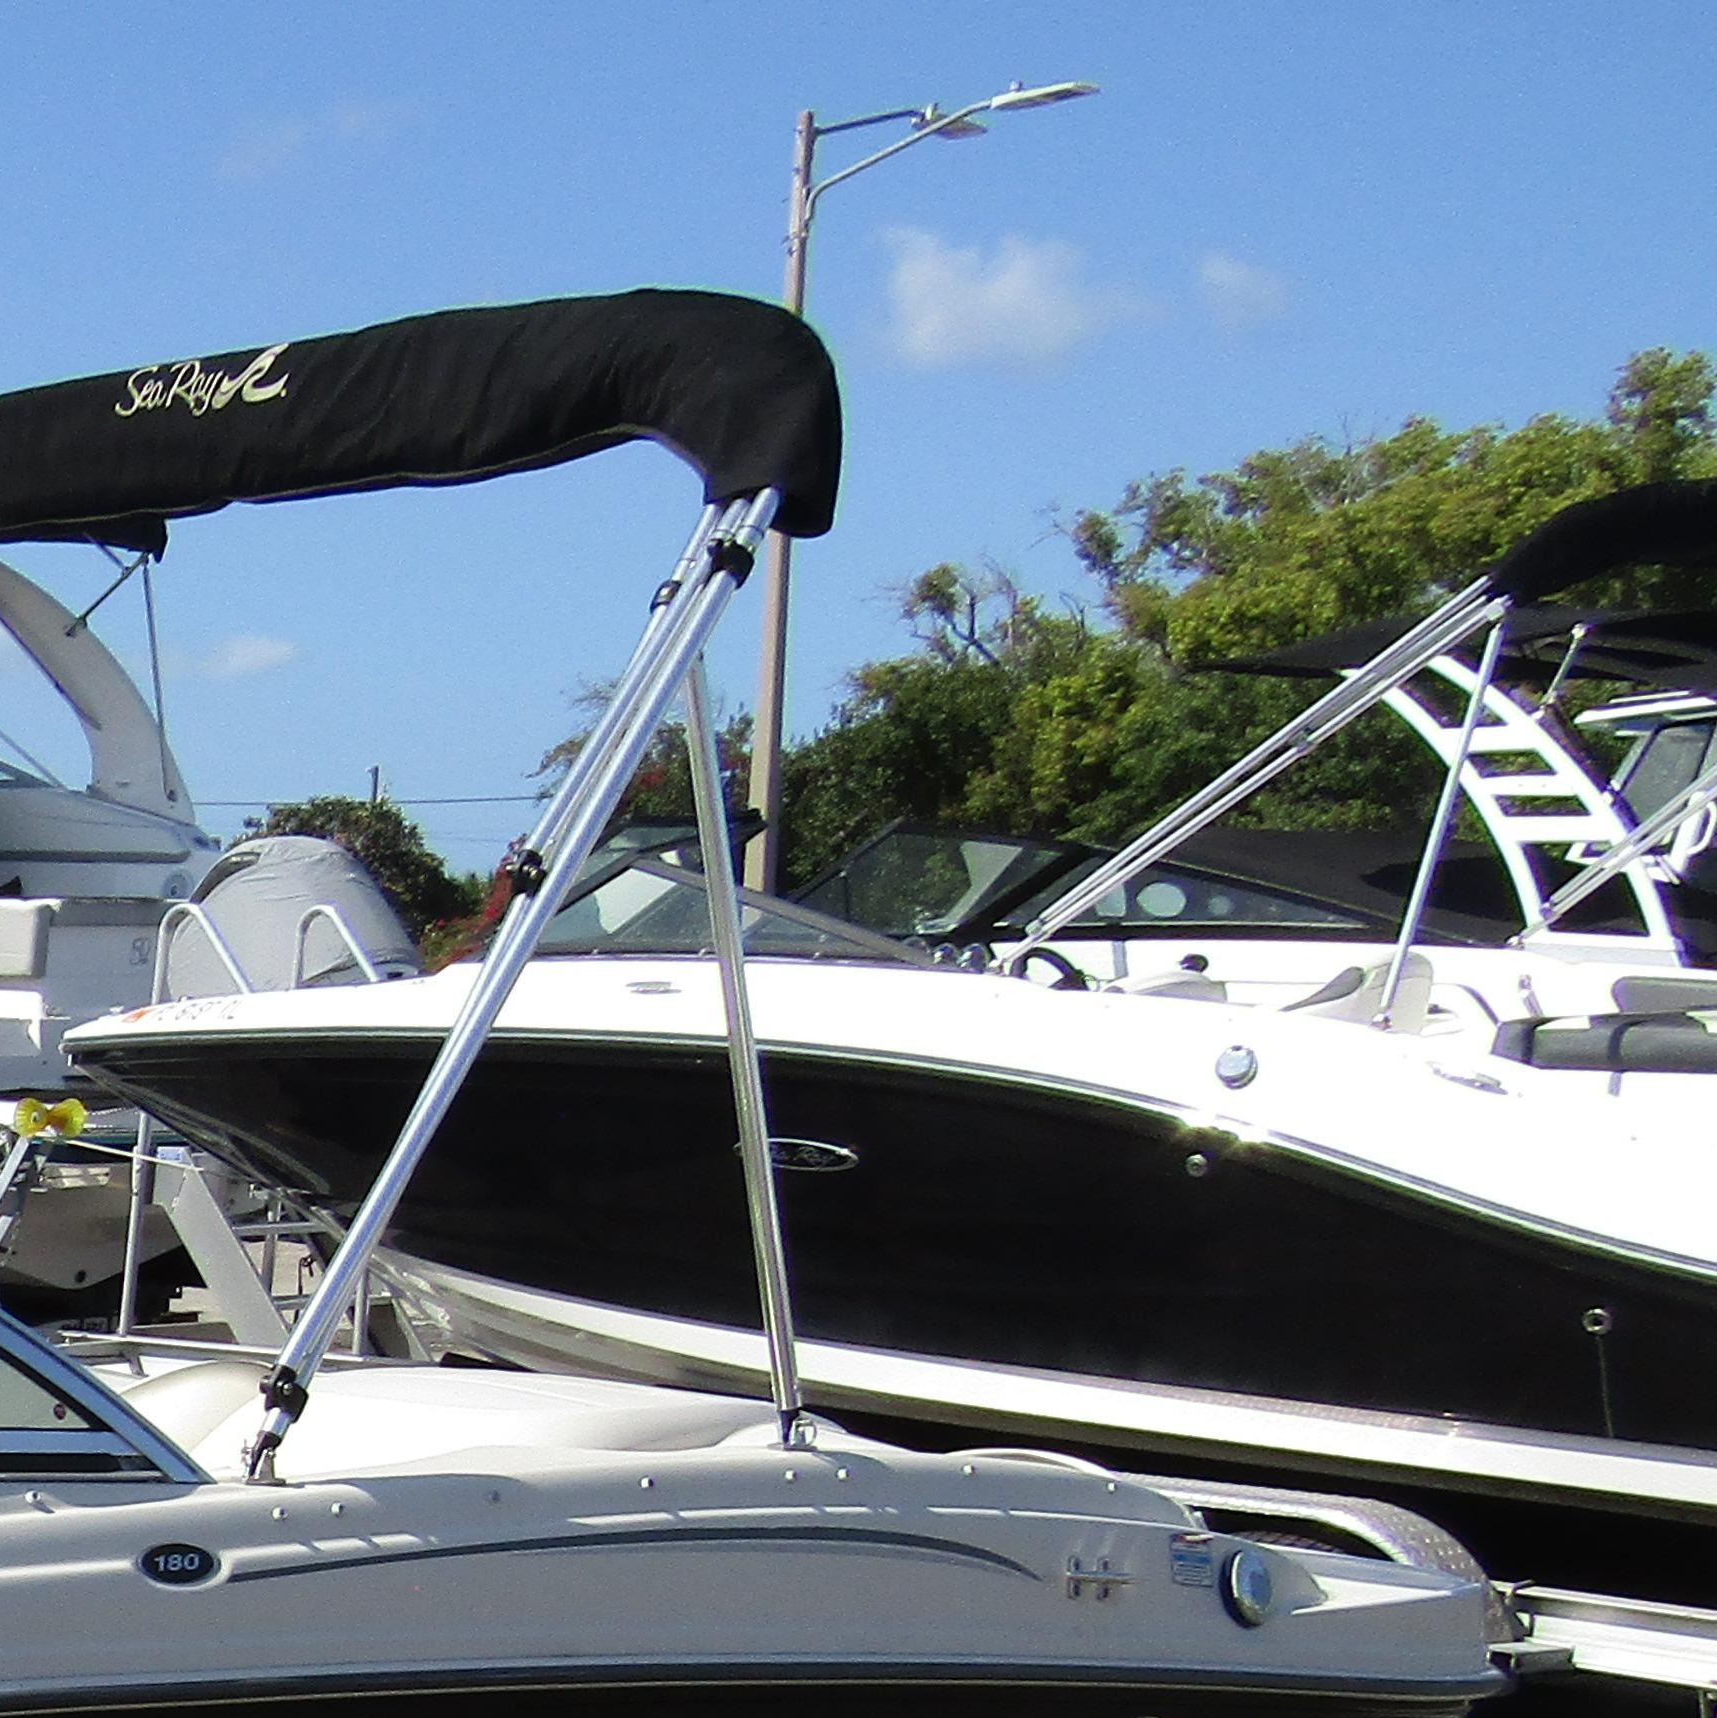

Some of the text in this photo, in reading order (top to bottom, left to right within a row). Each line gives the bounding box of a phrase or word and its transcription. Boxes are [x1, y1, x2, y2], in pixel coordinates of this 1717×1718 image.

[115, 360, 224, 418] Sea Ray
[153, 1553, 200, 1573] 180
